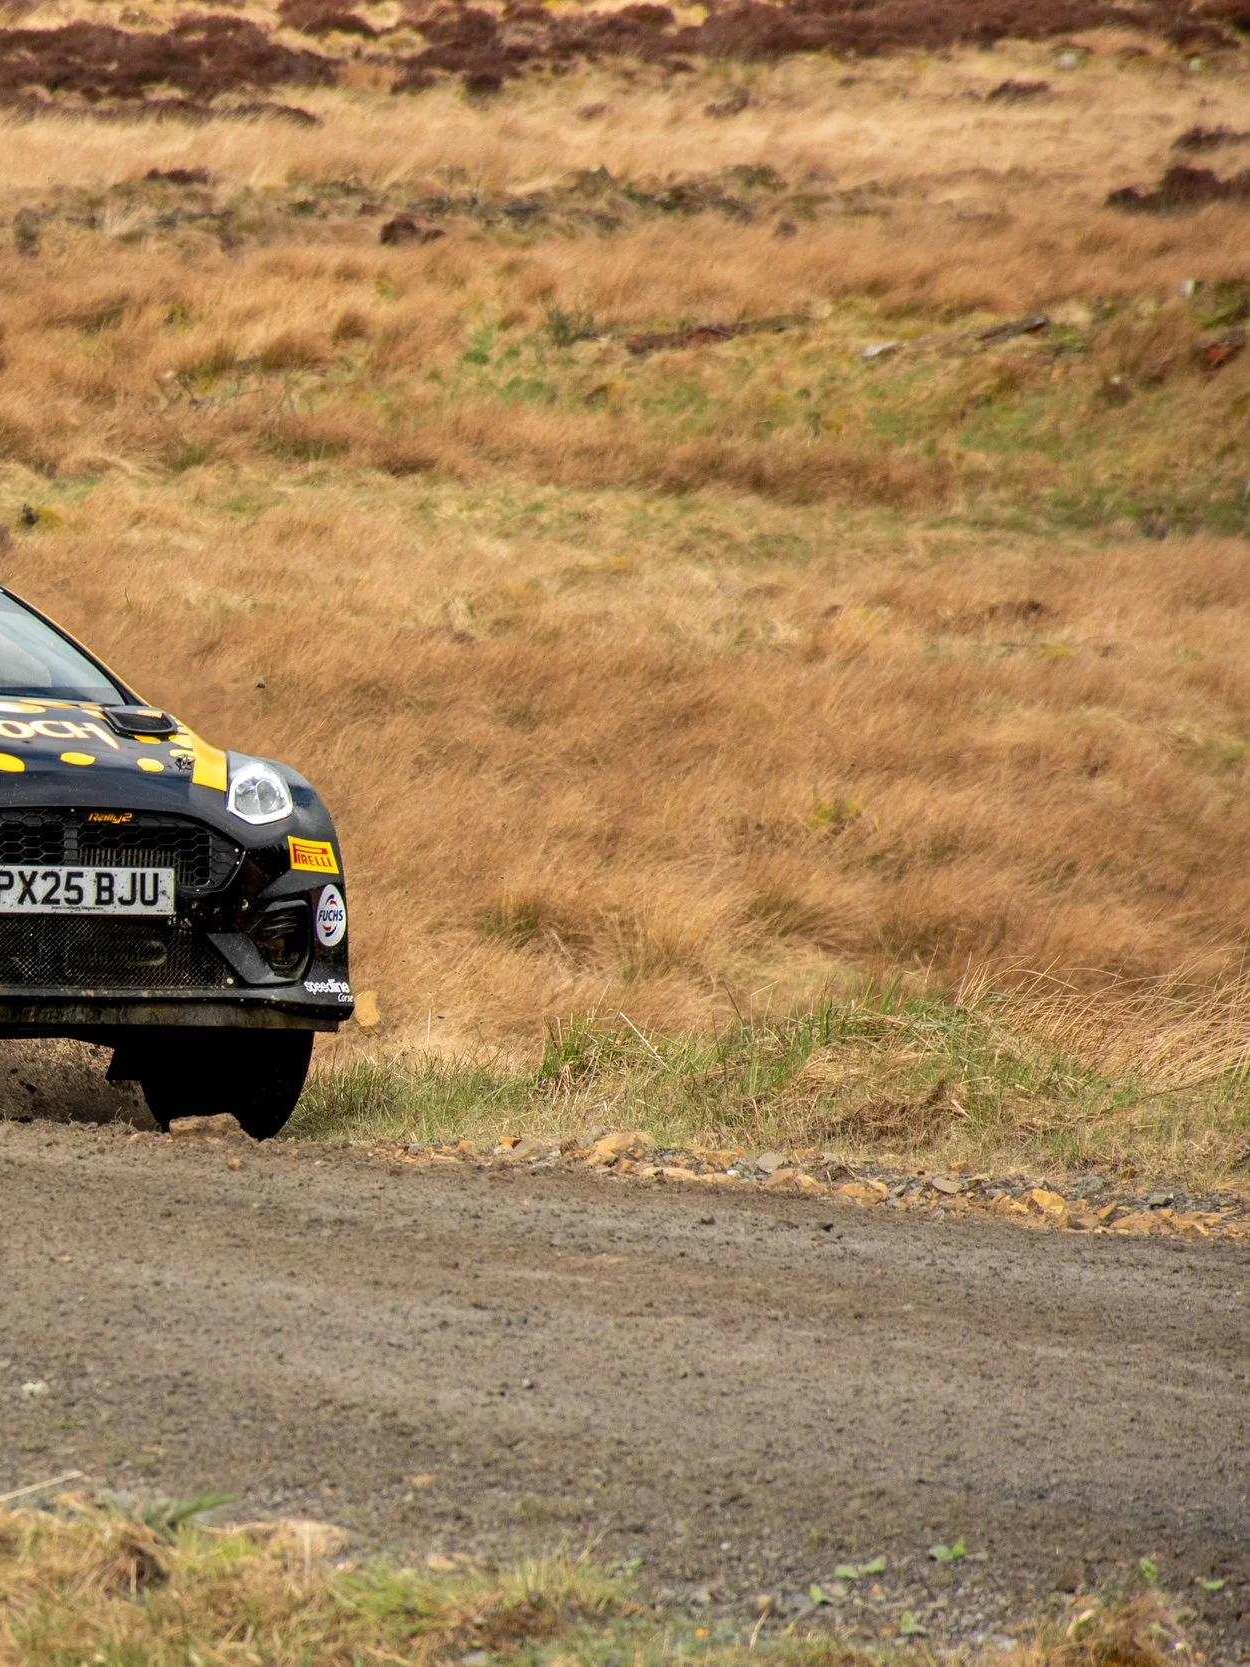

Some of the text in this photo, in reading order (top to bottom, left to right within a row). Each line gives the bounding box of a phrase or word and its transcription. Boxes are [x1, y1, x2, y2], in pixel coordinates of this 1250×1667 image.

[88, 812, 133, 824] Rally2
[292, 843, 333, 868] PIRELLI
[95, 871, 160, 907] BJU
[318, 910, 343, 922] FUCHS
[303, 979, 350, 994] speedline
[338, 992, 354, 1003] Corse
